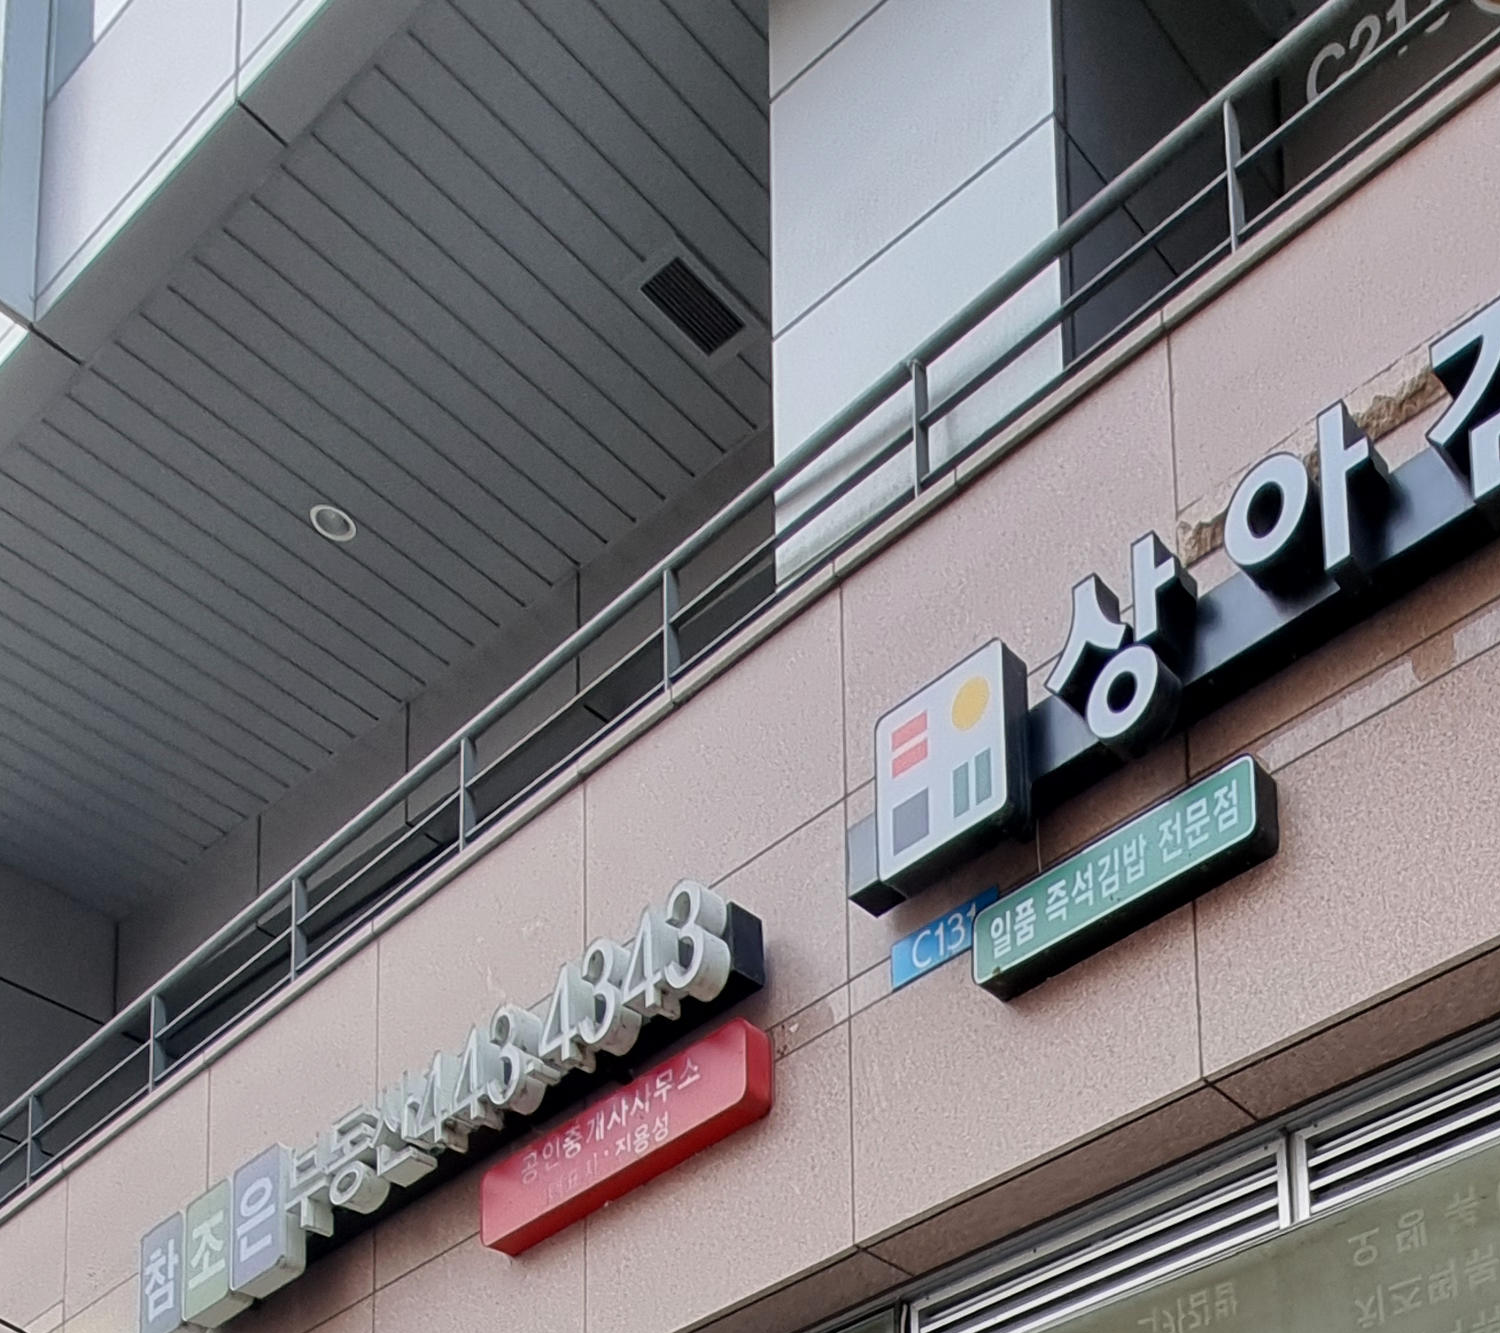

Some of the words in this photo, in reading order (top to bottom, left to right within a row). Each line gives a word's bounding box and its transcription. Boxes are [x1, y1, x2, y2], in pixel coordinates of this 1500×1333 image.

[989, 902, 1037, 959] 일품
[1044, 834, 1148, 926] 즉석김밥
[1158, 778, 1240, 864] 전문점
[521, 1055, 701, 1185] 공인중개사사무소
[142, 1176, 277, 1323] 참조은
